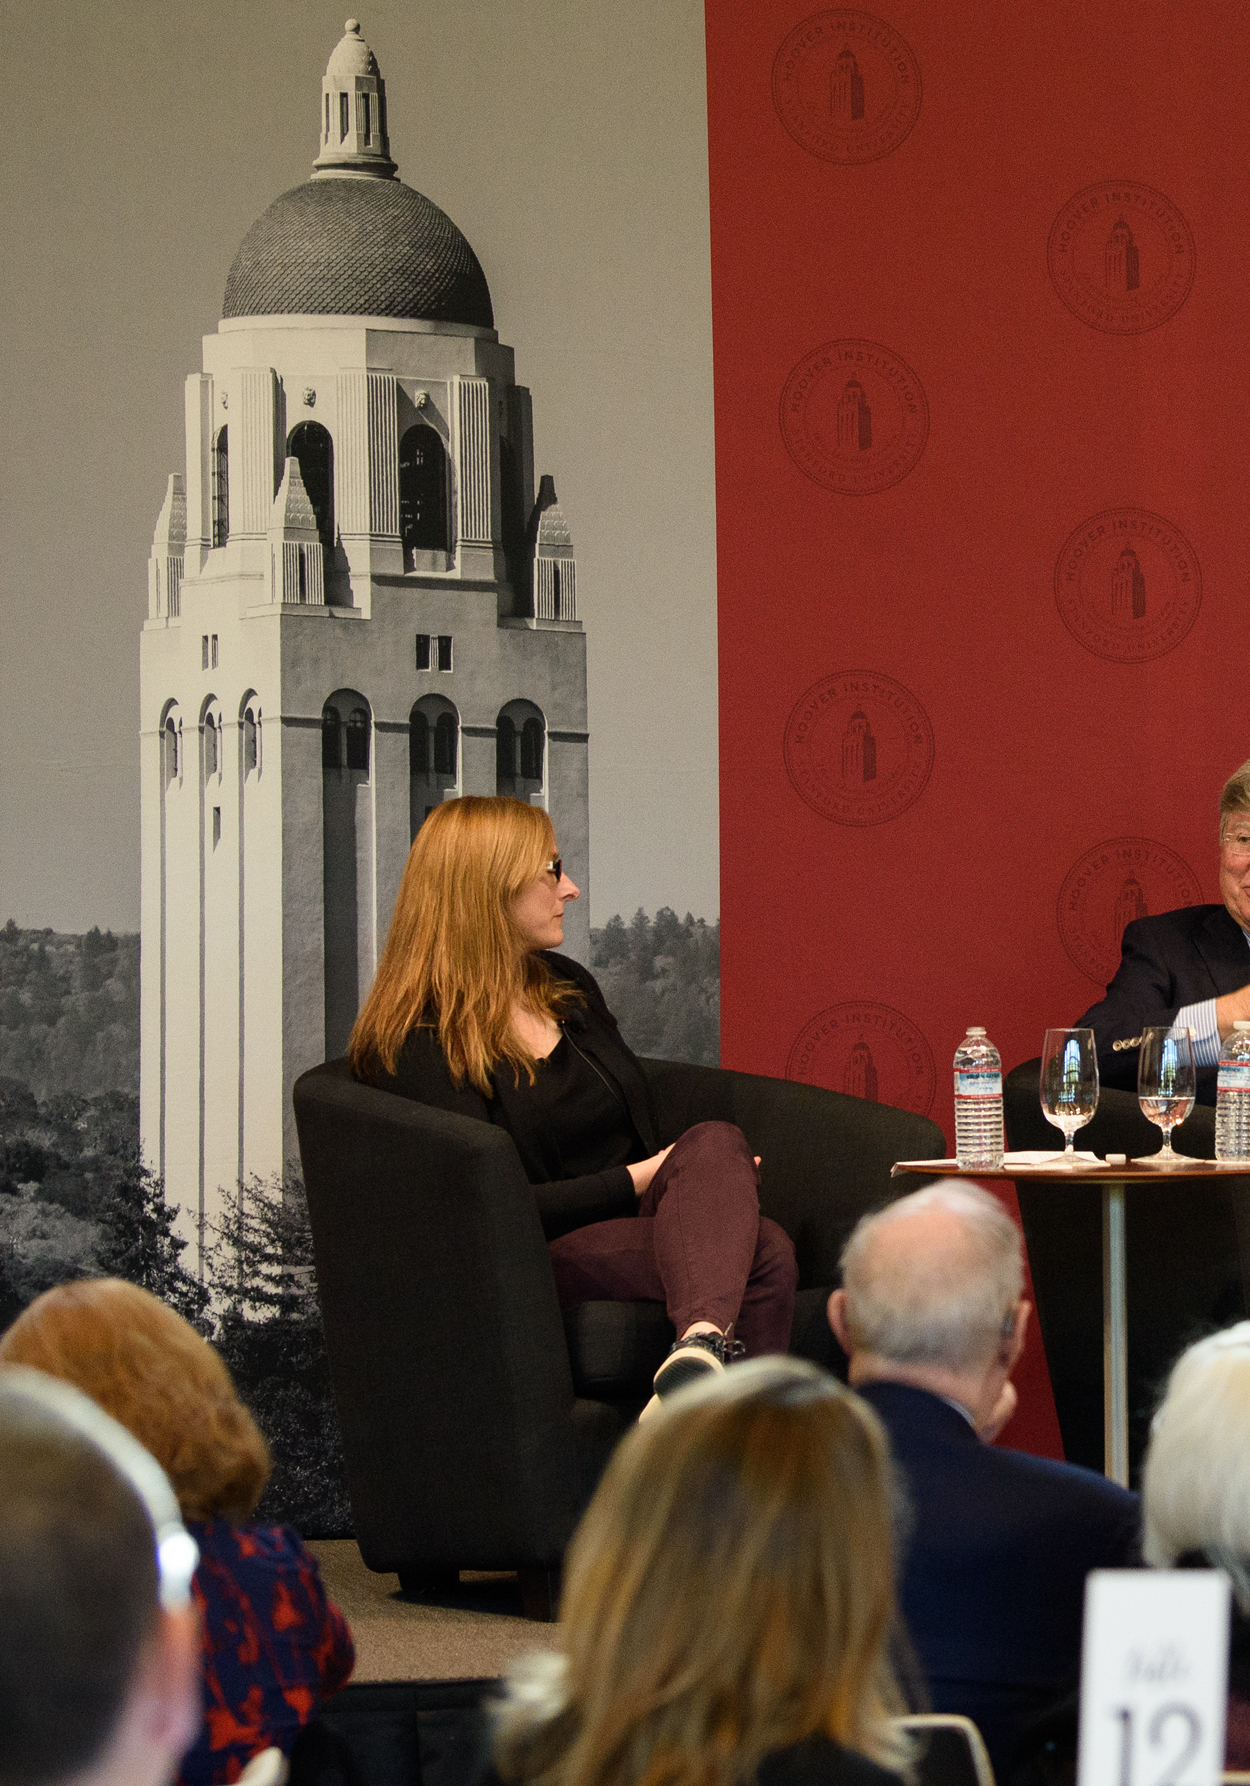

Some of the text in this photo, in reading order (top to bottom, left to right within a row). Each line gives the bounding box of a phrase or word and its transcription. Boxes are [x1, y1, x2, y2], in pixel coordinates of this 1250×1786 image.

[784, 21, 910, 84] HOOVER INSTITUTION
[1059, 192, 1184, 255] HOOVER INSTITUTION
[792, 350, 917, 414] HOOVER INSTITUTION
[1066, 520, 1190, 582] HOOVER INSTITUTION
[796, 682, 922, 745] HOOVER INSTITUTION
[1069, 855, 1109, 911] HOOVER
[798, 1013, 924, 1075] HOOVER INSTITUTION
[1111, 1699, 1203, 1786] 12
